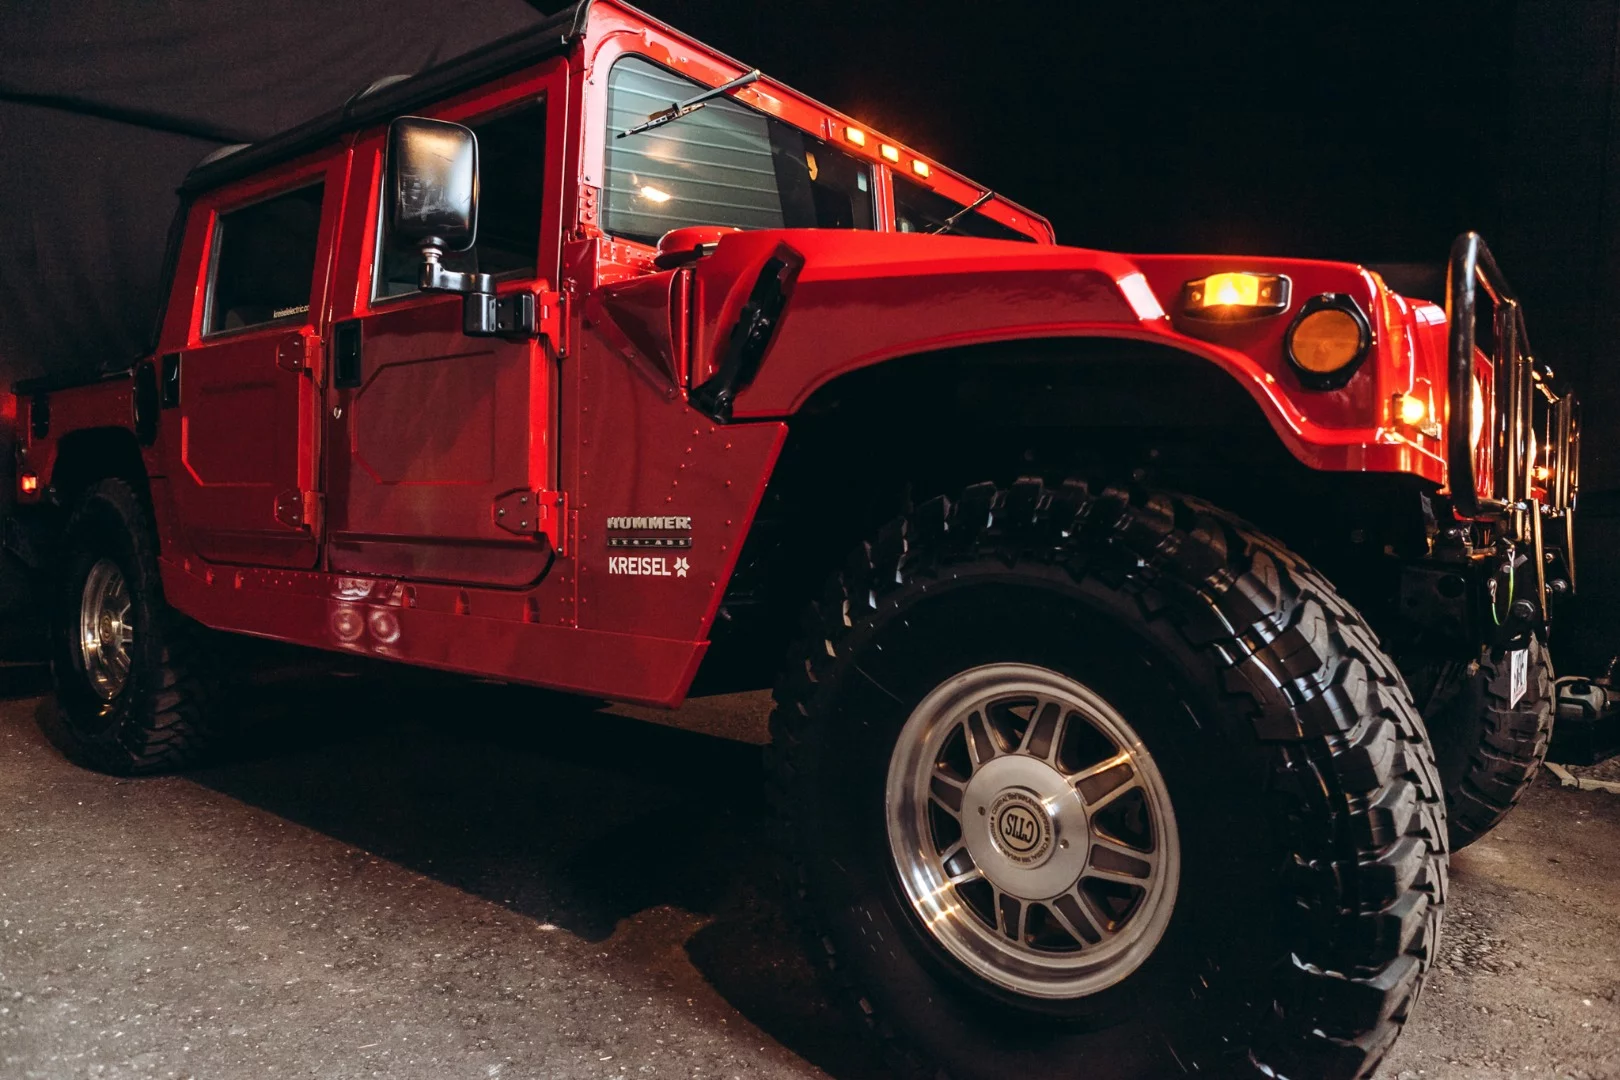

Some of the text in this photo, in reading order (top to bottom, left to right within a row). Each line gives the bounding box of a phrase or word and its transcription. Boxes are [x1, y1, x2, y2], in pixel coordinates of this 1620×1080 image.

[607, 516, 692, 530] HUMMER
[609, 556, 672, 576] KREISEL
[1005, 813, 1035, 844] CTIS
